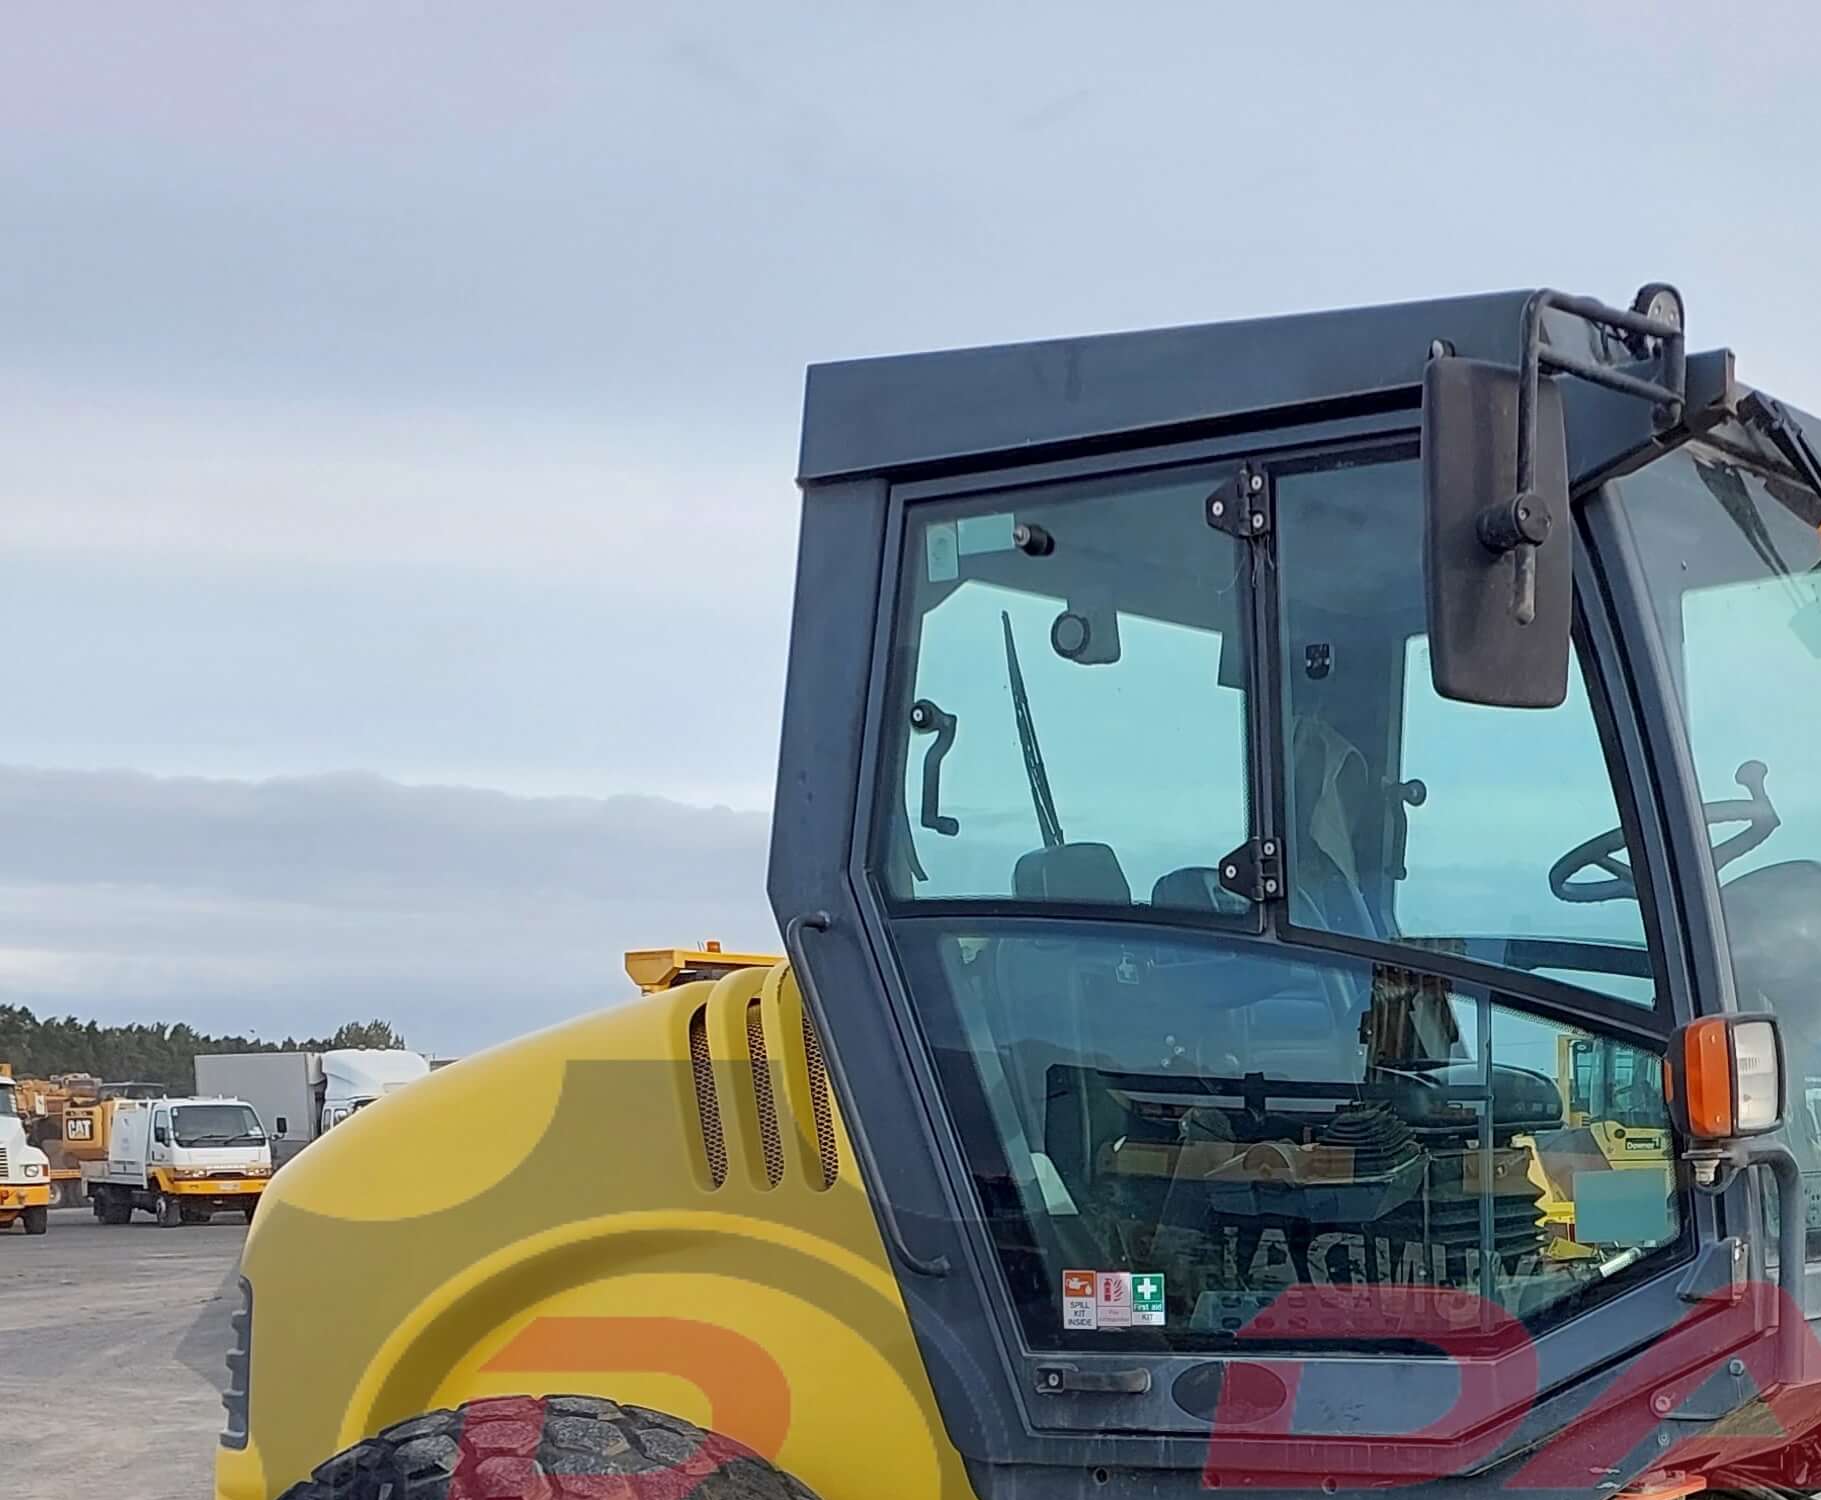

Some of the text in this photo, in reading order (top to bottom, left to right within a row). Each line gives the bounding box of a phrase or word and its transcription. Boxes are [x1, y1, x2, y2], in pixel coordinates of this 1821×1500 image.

[68, 1119, 91, 1138] CAT
[1069, 1301, 1090, 1309] SPILL
[1133, 1303, 1162, 1311] First aid
[1073, 1310, 1085, 1318] KIT
[1067, 1319, 1092, 1327] INSIDE
